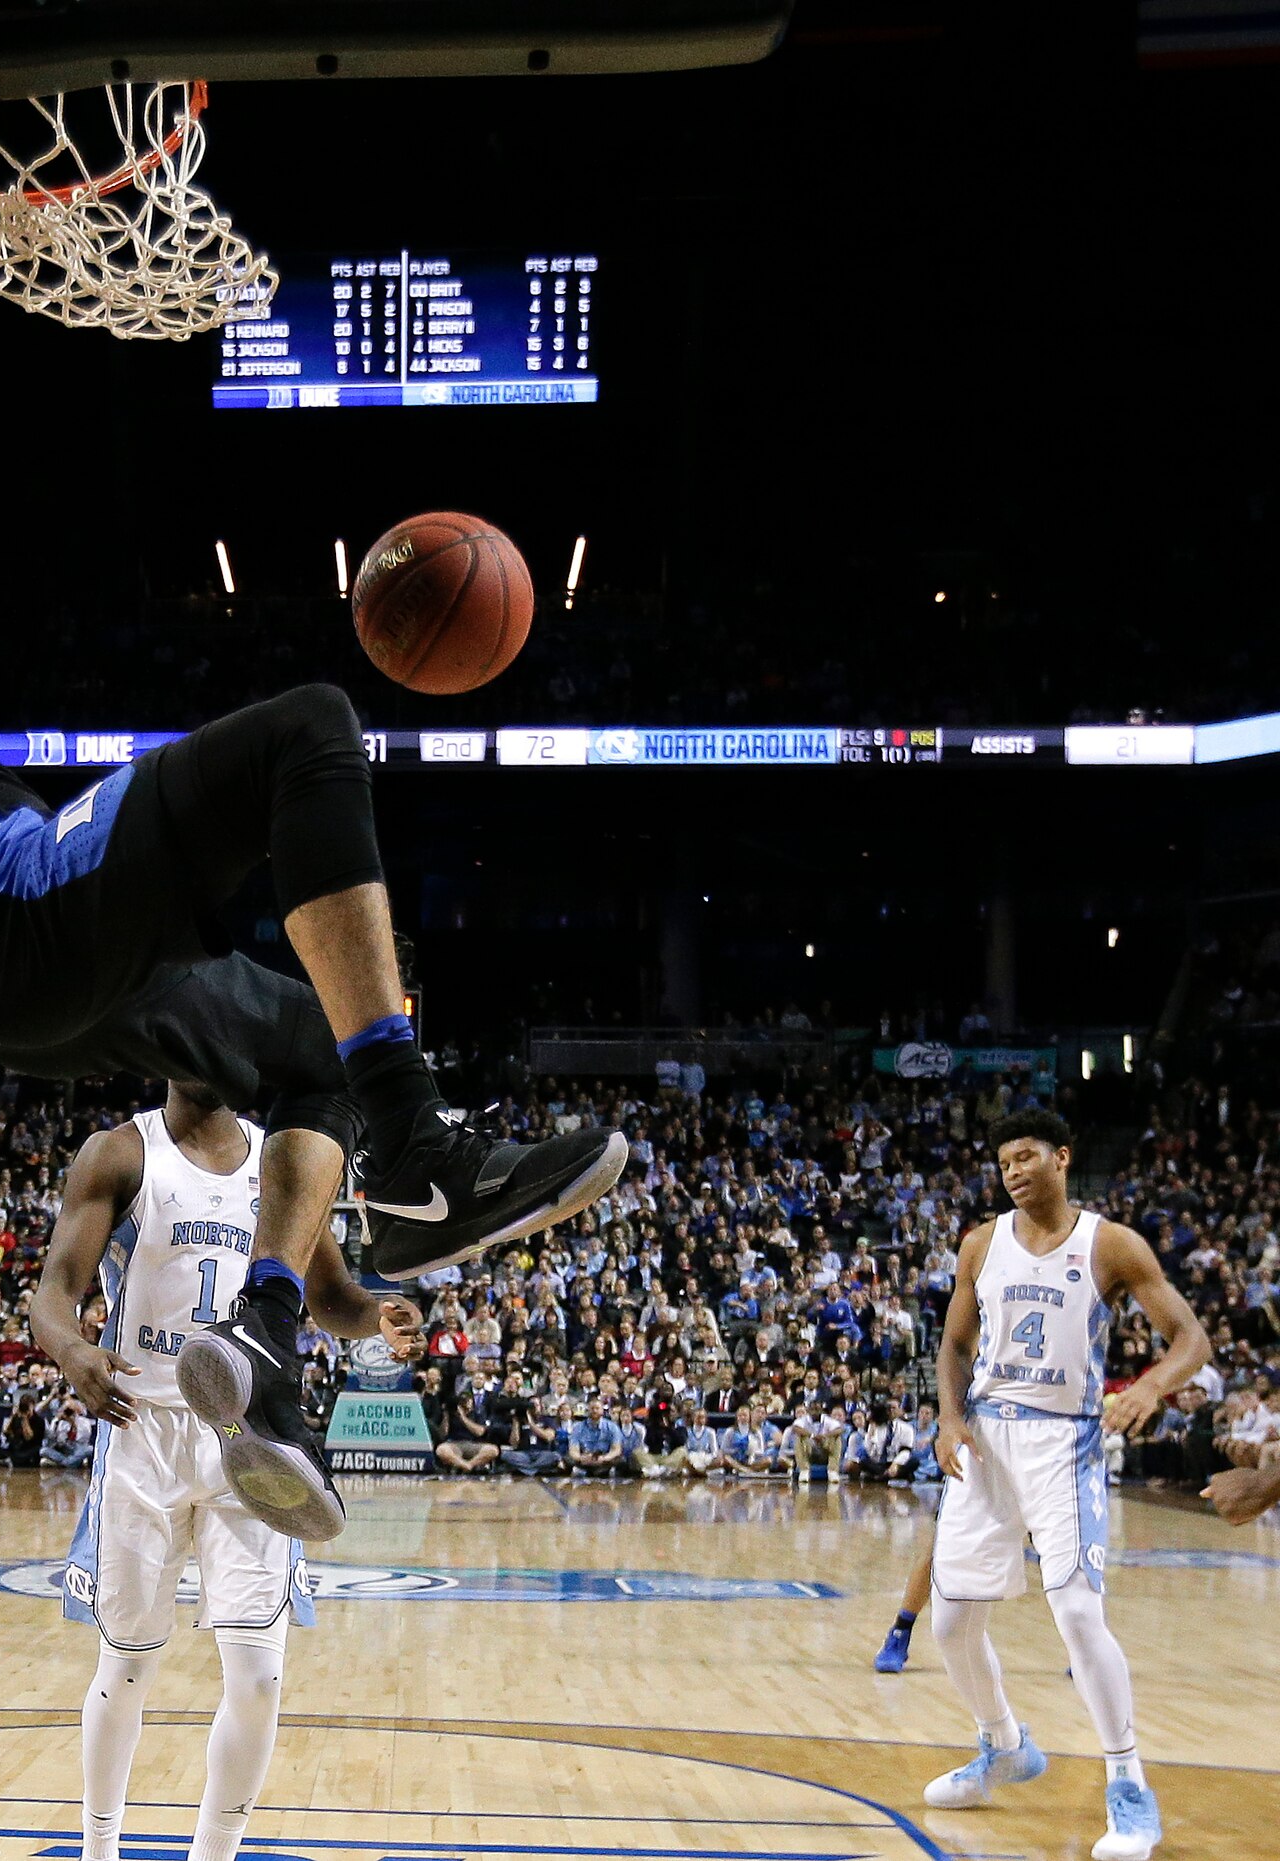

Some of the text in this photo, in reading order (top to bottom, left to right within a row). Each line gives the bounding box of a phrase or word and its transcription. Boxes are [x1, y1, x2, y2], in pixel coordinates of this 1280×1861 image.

[331, 263, 400, 277] PTS AST REB
[410, 261, 450, 275] PLAYER
[525, 258, 598, 273] PTS AST REB
[333, 284, 396, 299] 20 2 7
[429, 282, 463, 297] BRITT
[554, 280, 567, 294] 2
[336, 303, 350, 317] 17
[384, 303, 396, 317] 2
[428, 301, 473, 316] PINSON
[529, 299, 541, 313] 4
[333, 322, 352, 336] 20
[413, 321, 424, 335] 2
[529, 318, 541, 332] 7
[222, 342, 289, 357] 15 JACKSON
[335, 341, 350, 355] 10
[384, 340, 396, 354] 4
[413, 339, 463, 353] 4 HICKS
[222, 361, 302, 376] 21 JEFFERSON
[384, 359, 396, 373] 4
[410, 357, 481, 372] 44 JACKSON
[552, 355, 564, 369] 4
[577, 355, 588, 369] 4
[299, 387, 341, 407] DUKE
[451, 386, 502, 404] NORTH
[503, 384, 575, 402] CAROLINA
[873, 729, 886, 746] 9
[971, 736, 1036, 754] ASSISTS
[76, 735, 134, 763] DUKE
[432, 737, 471, 758] 2nd
[526, 735, 556, 759] 72
[644, 733, 716, 760] NORTH
[722, 733, 829, 759] CAROLINA
[171, 1221, 252, 1256] NORTH
[191, 1258, 218, 1324] 1
[1002, 1284, 1065, 1309] NORTH
[1011, 1311, 1045, 1360] 4
[989, 1362, 1066, 1386] AROLINA
[347, 1405, 412, 1419] @ACCMBB
[331, 1451, 426, 1471] #ACCTOURNEY
